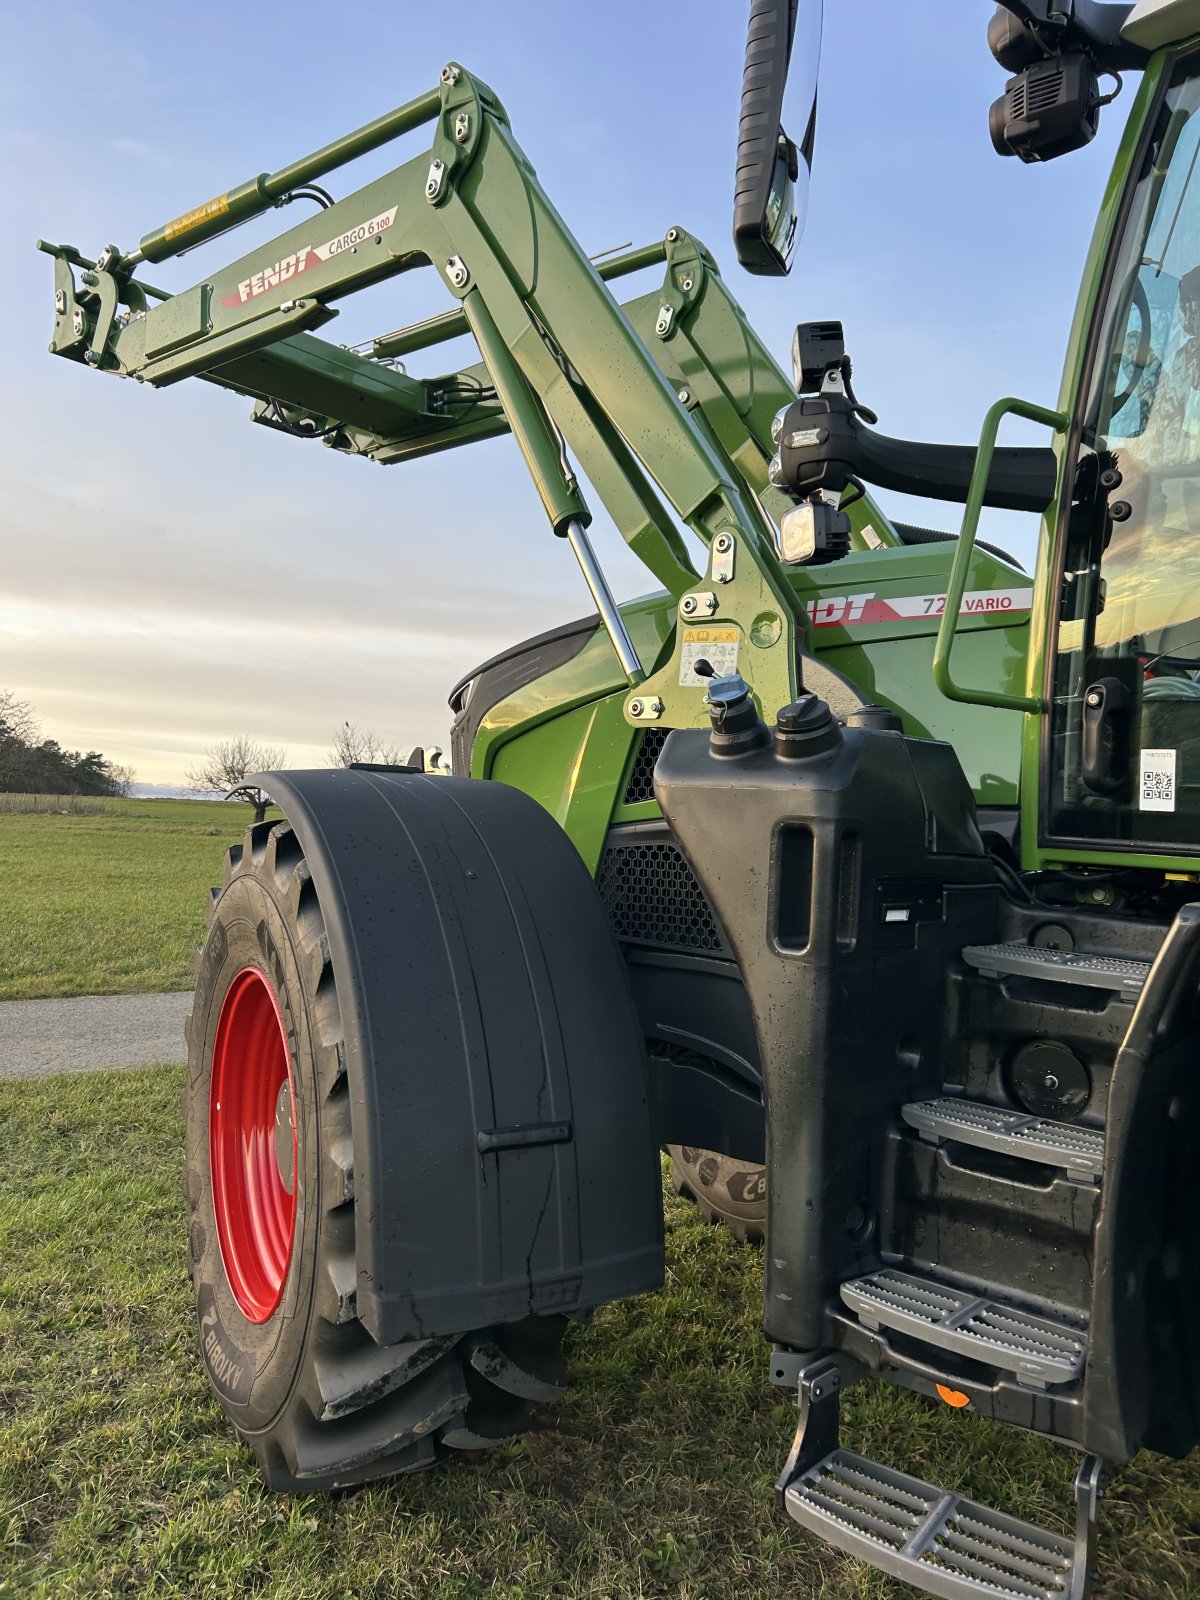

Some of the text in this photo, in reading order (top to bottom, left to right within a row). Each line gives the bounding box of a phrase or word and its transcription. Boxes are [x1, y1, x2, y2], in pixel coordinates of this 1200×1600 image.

[238, 216, 390, 302] FENDT CARGO 6 100
[923, 597, 946, 614] 72
[965, 596, 1012, 611] VARIO
[201, 1304, 244, 1390] AXIOBIB 2
